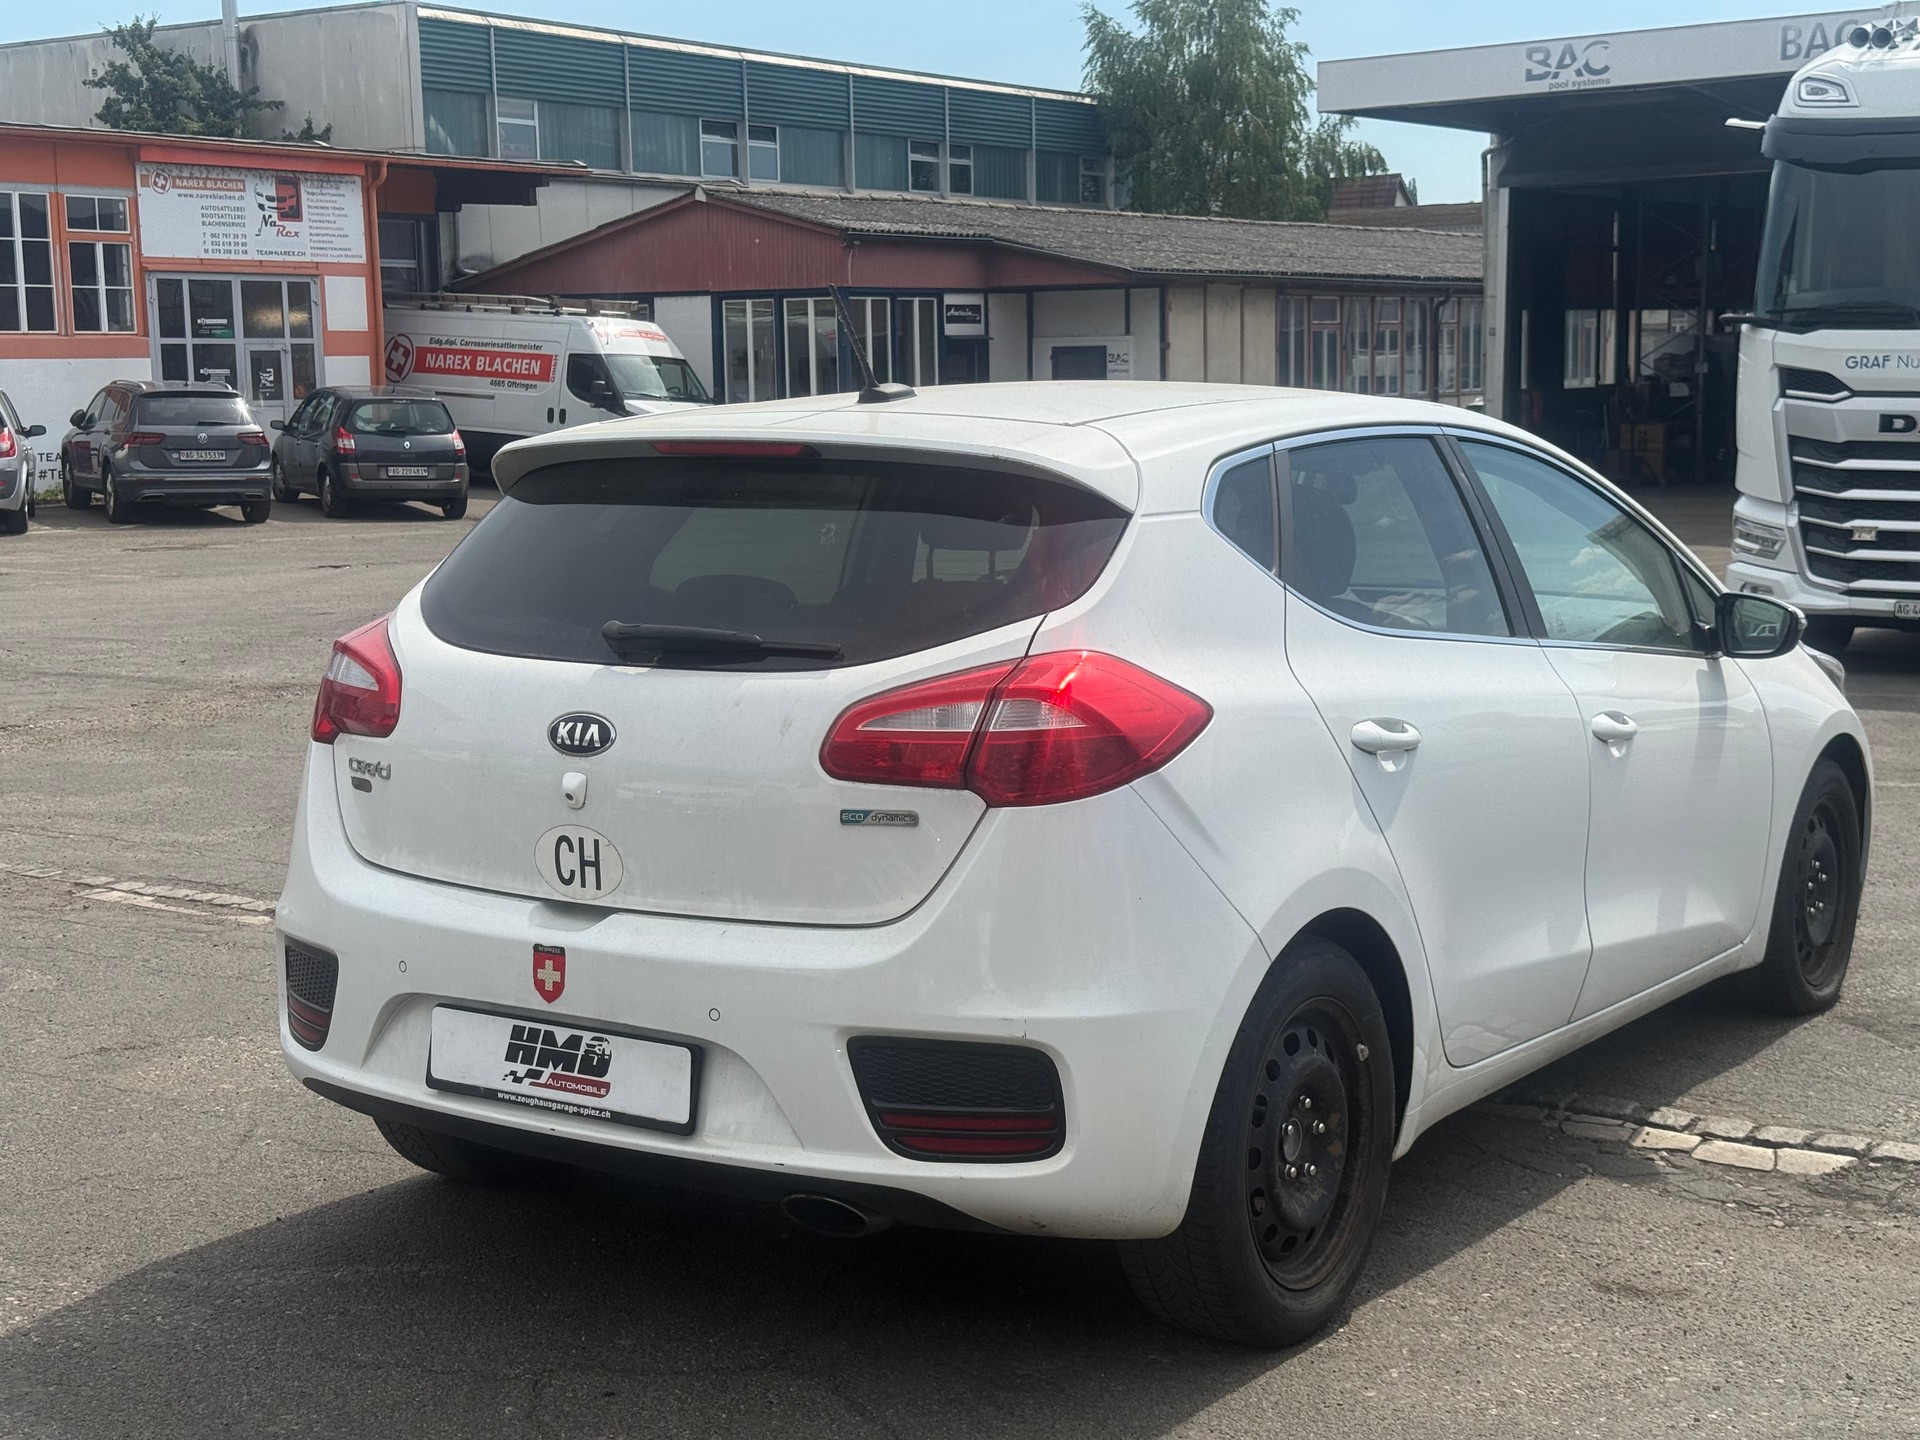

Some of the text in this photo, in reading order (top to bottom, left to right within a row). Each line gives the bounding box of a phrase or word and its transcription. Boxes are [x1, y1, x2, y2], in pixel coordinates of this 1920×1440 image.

[1525, 40, 1610, 82] BAC
[1548, 77, 1611, 91] pool systems
[176, 179, 244, 190] NAREX BLACHEN
[177, 192, 245, 201] www.narexblachen.ch
[256, 249, 307, 258] TEAM-NAREX.CH
[429, 337, 543, 351] Eidg.dipl. Carrosseriesattlermeister
[425, 353, 542, 376] NAREX BLACHEN
[1107, 352, 1129, 364] BAC
[1845, 354, 1920, 369] GRAF Nu
[551, 354, 559, 384] GmbH
[489, 378, 538, 391] 4665 Oftringen
[1879, 414, 1920, 433] D
[37, 452, 62, 463] TEA
[38, 469, 64, 480] #TE
[1896, 603, 1920, 615] AG·4
[556, 721, 601, 747] KIA
[842, 813, 917, 824] ECO dynamics
[554, 834, 602, 891] CH
[546, 1078, 608, 1096] AUTOMOBILE
[497, 1091, 612, 1119] www.zeughausgarage-spiez.ch
